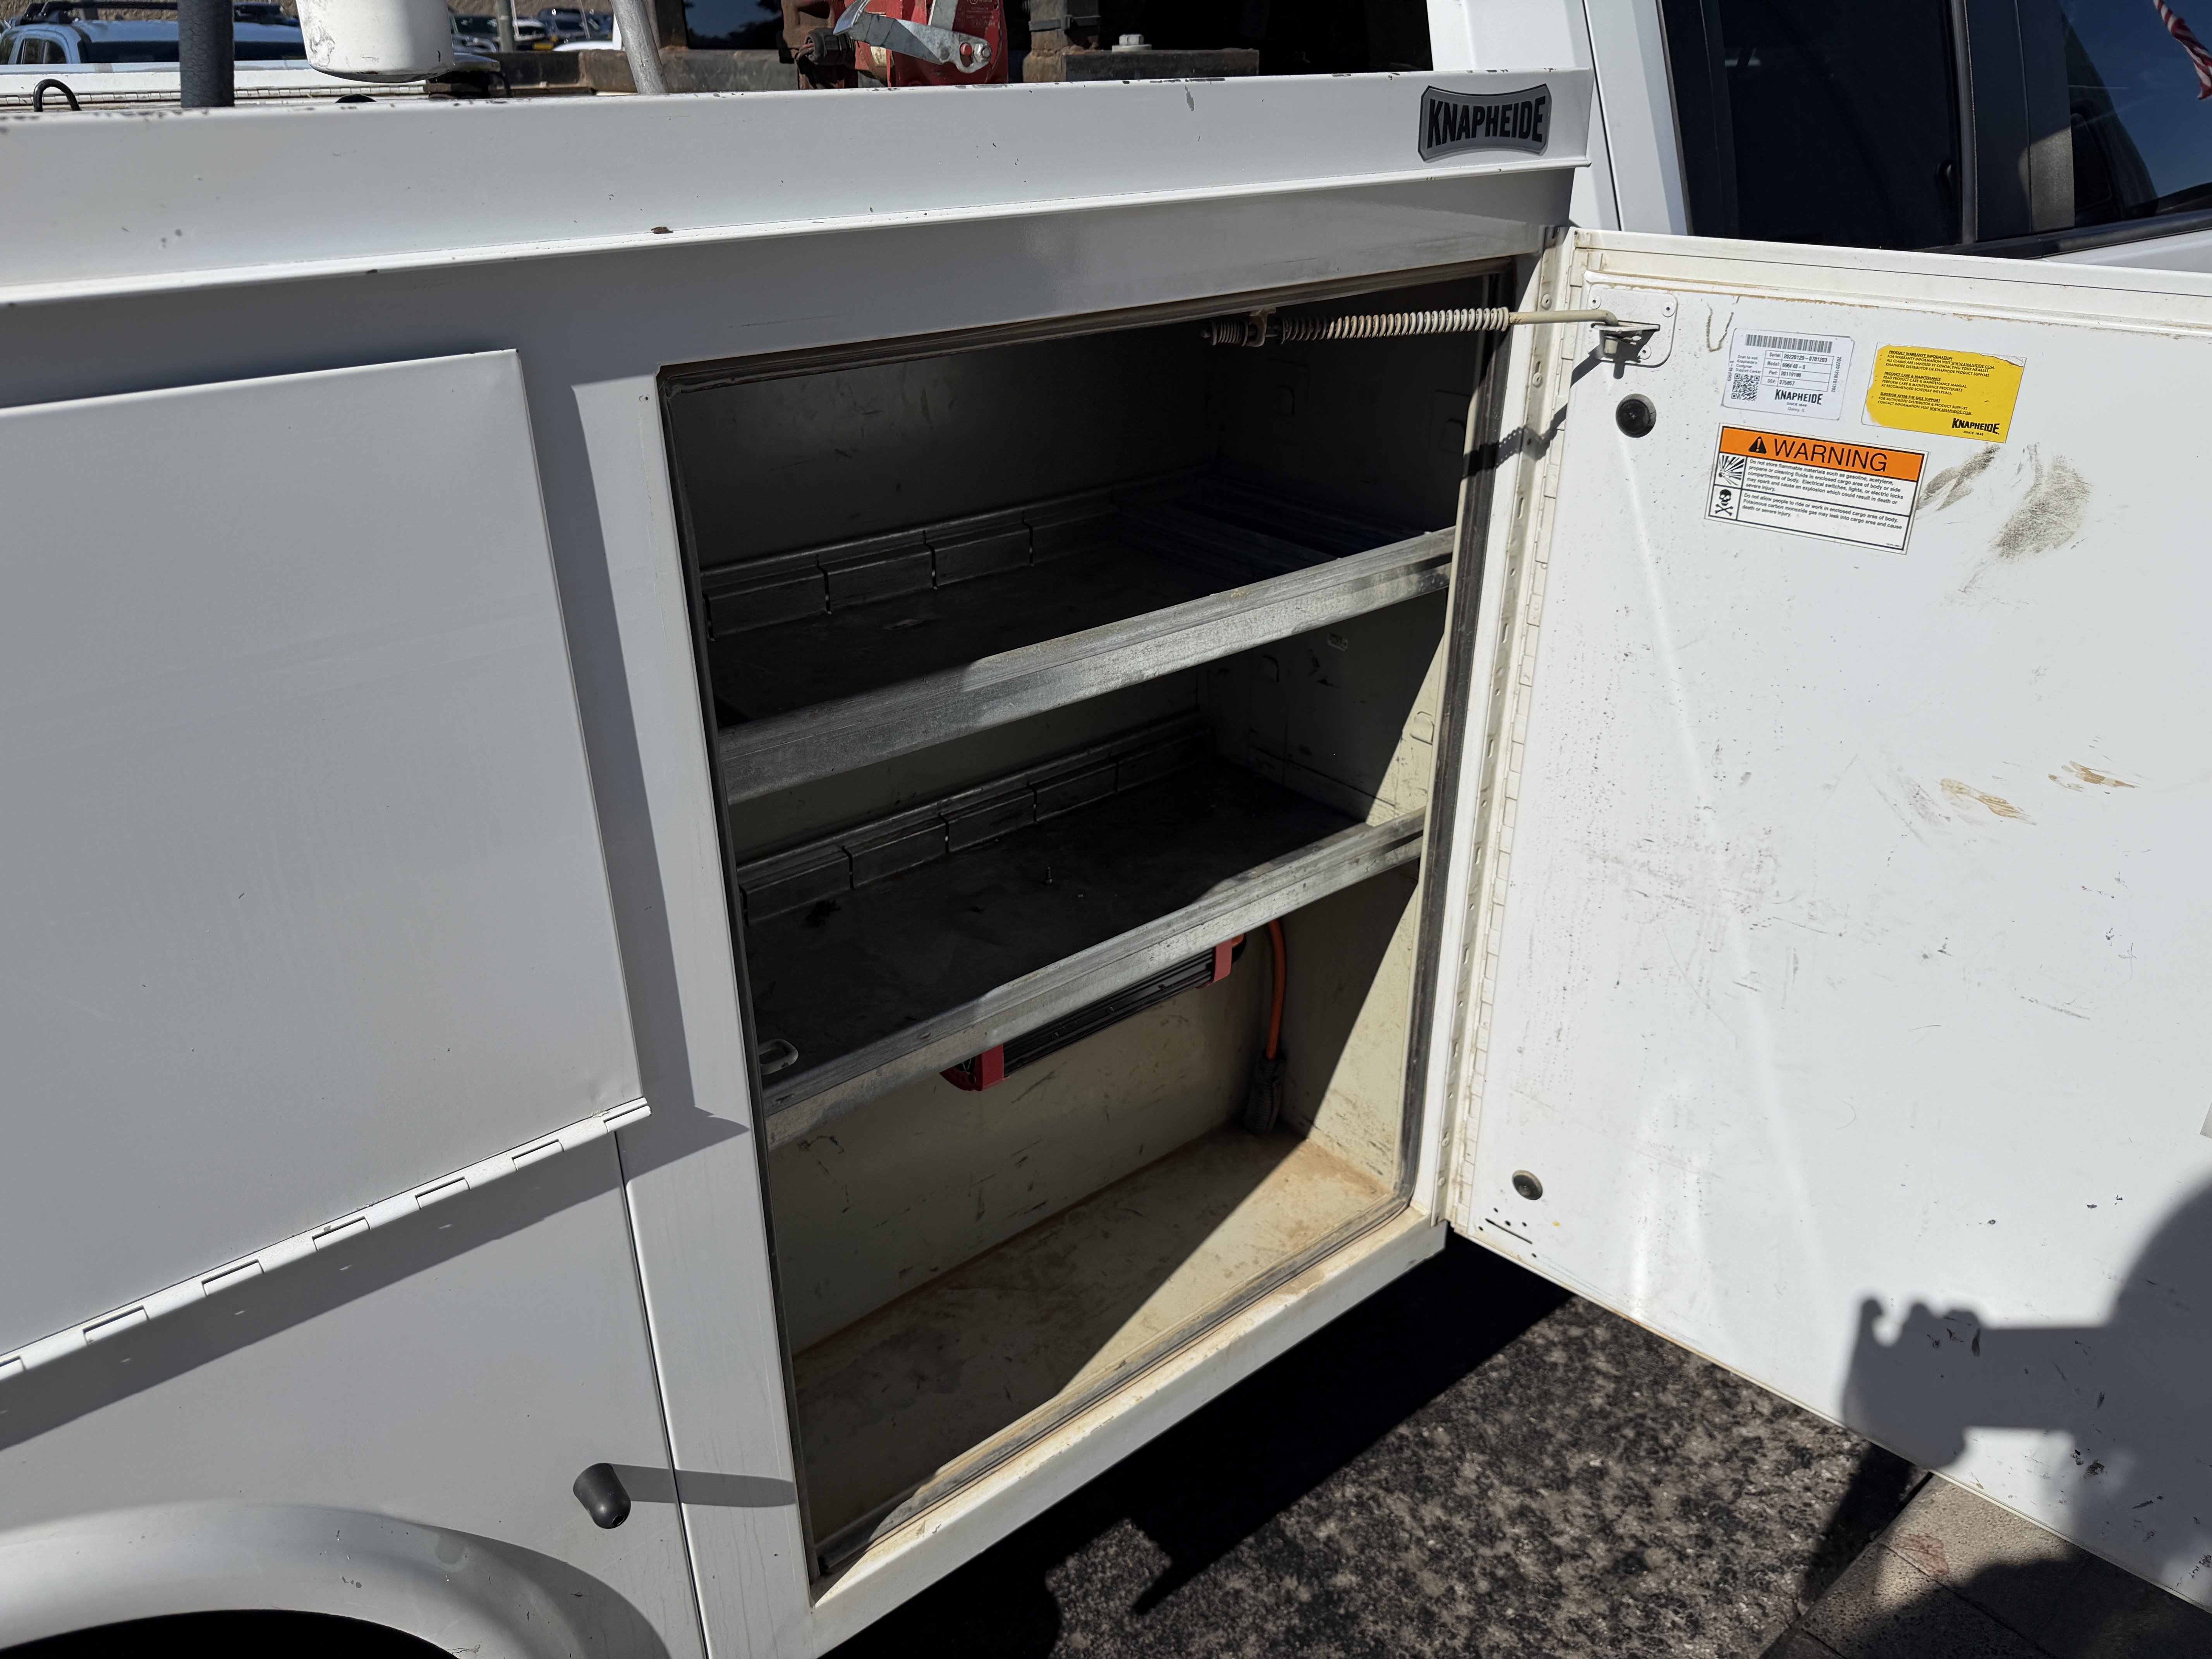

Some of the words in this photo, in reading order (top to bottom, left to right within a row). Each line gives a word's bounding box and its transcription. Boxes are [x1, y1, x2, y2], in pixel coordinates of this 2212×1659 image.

[1427, 95, 1546, 149] KNAPHEIDE
[1774, 388, 1823, 405] KNAPHEIDE
[1951, 417, 2000, 434] KNAPHEIDE
[1774, 439, 1888, 472] WARNING
[1774, 469, 1795, 477] cleaning
[1778, 463, 1803, 471] flammable
[1845, 473, 1869, 482] gasoline,
[1868, 477, 1894, 486] acetylene,
[1747, 471, 1781, 481] compartments
[1802, 479, 1825, 487] Electrical
[1824, 483, 1848, 491] switches,
[1848, 486, 1864, 494] lights,
[1802, 485, 1826, 494] explosion
[1743, 498, 1767, 507] Poisonous
[1784, 505, 1808, 514] monoxide
[1772, 497, 1789, 505] people
[1829, 507, 1852, 515] enclosed
